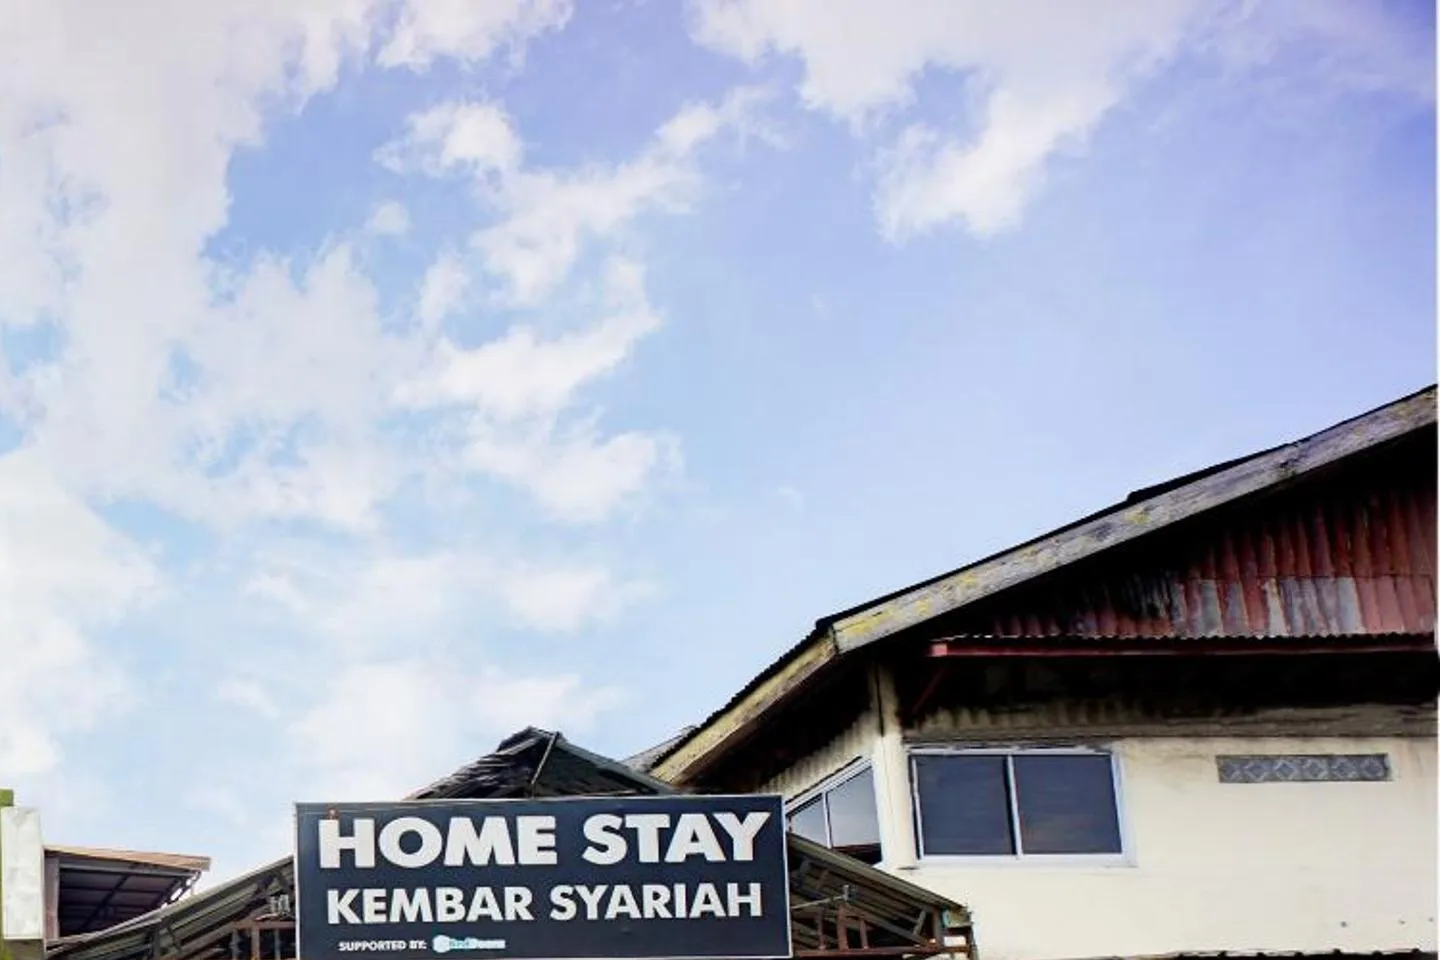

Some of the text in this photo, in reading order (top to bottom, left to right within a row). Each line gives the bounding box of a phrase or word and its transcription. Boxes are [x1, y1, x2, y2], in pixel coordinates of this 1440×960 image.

[318, 811, 773, 869] HOME STAY
[327, 882, 763, 925] KEMBAR SYARIAH
[338, 939, 407, 952] SUPPORTED
